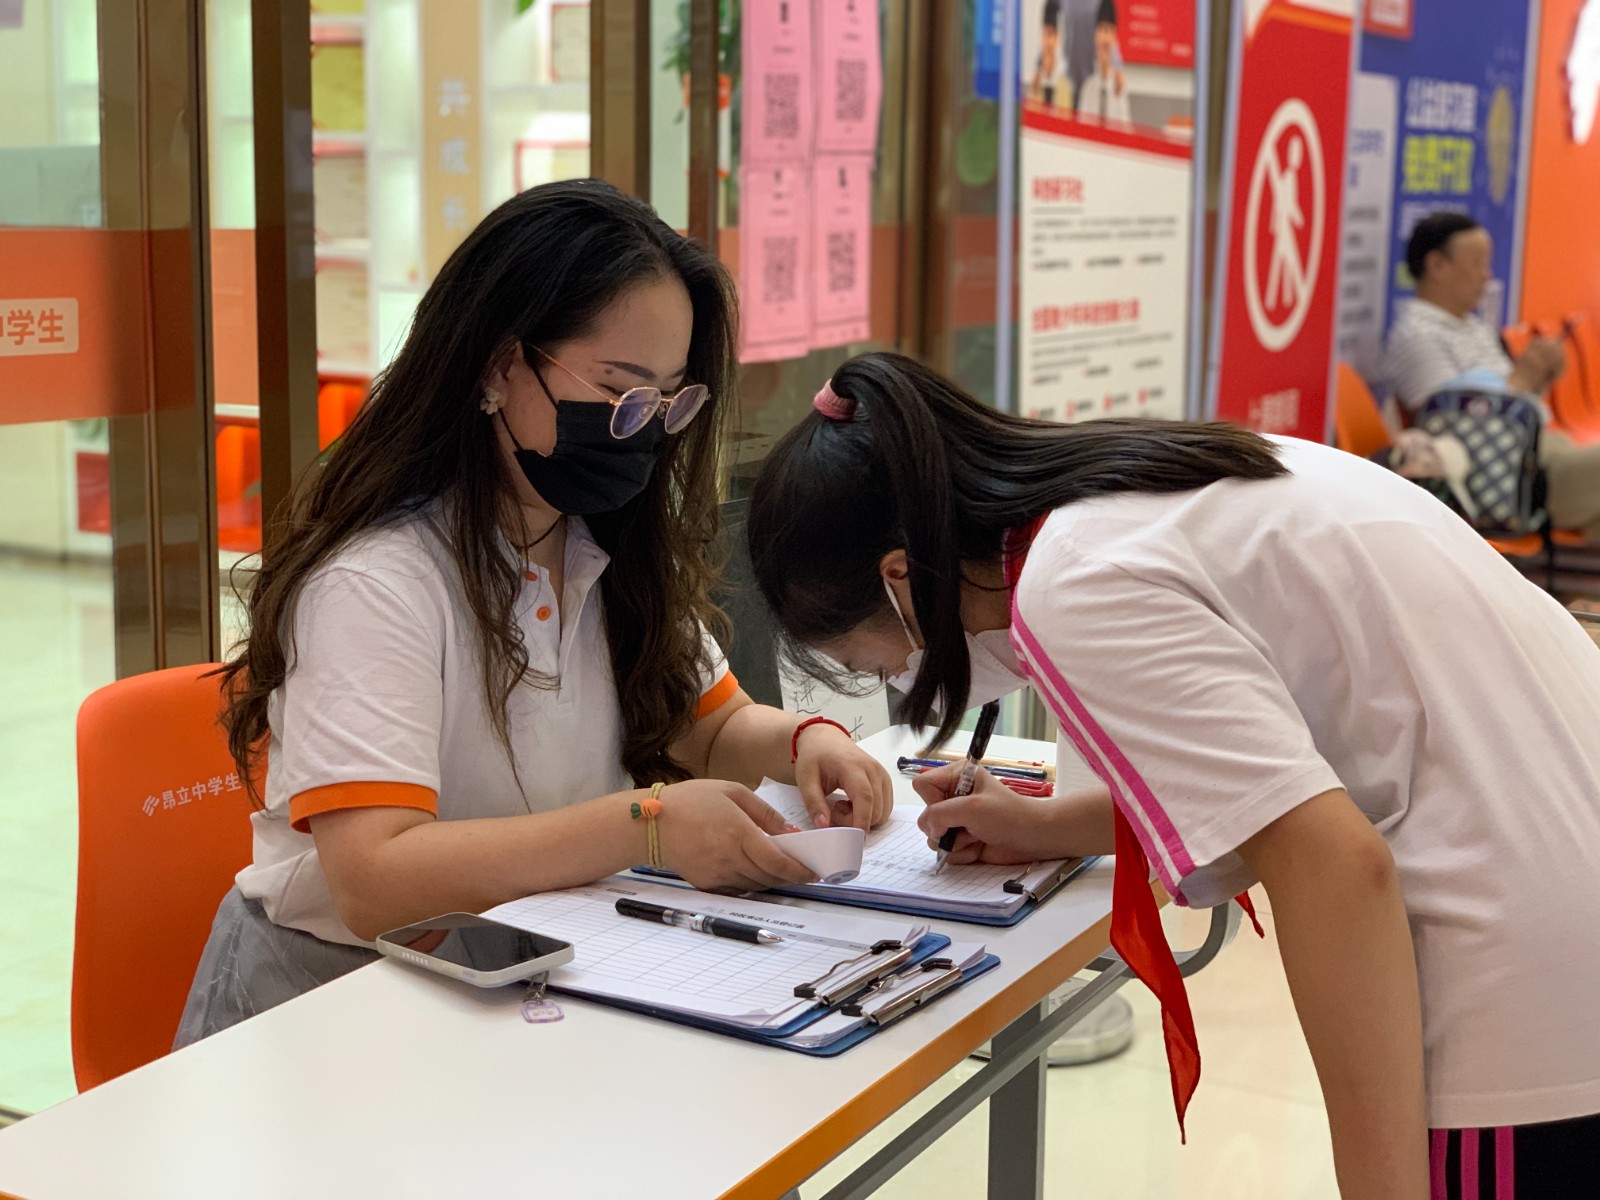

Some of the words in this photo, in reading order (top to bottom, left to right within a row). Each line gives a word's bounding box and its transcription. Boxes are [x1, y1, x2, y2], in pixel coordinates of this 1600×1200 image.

[0, 308, 65, 345] 学生
[162, 772, 242, 810] 昂立中学生
